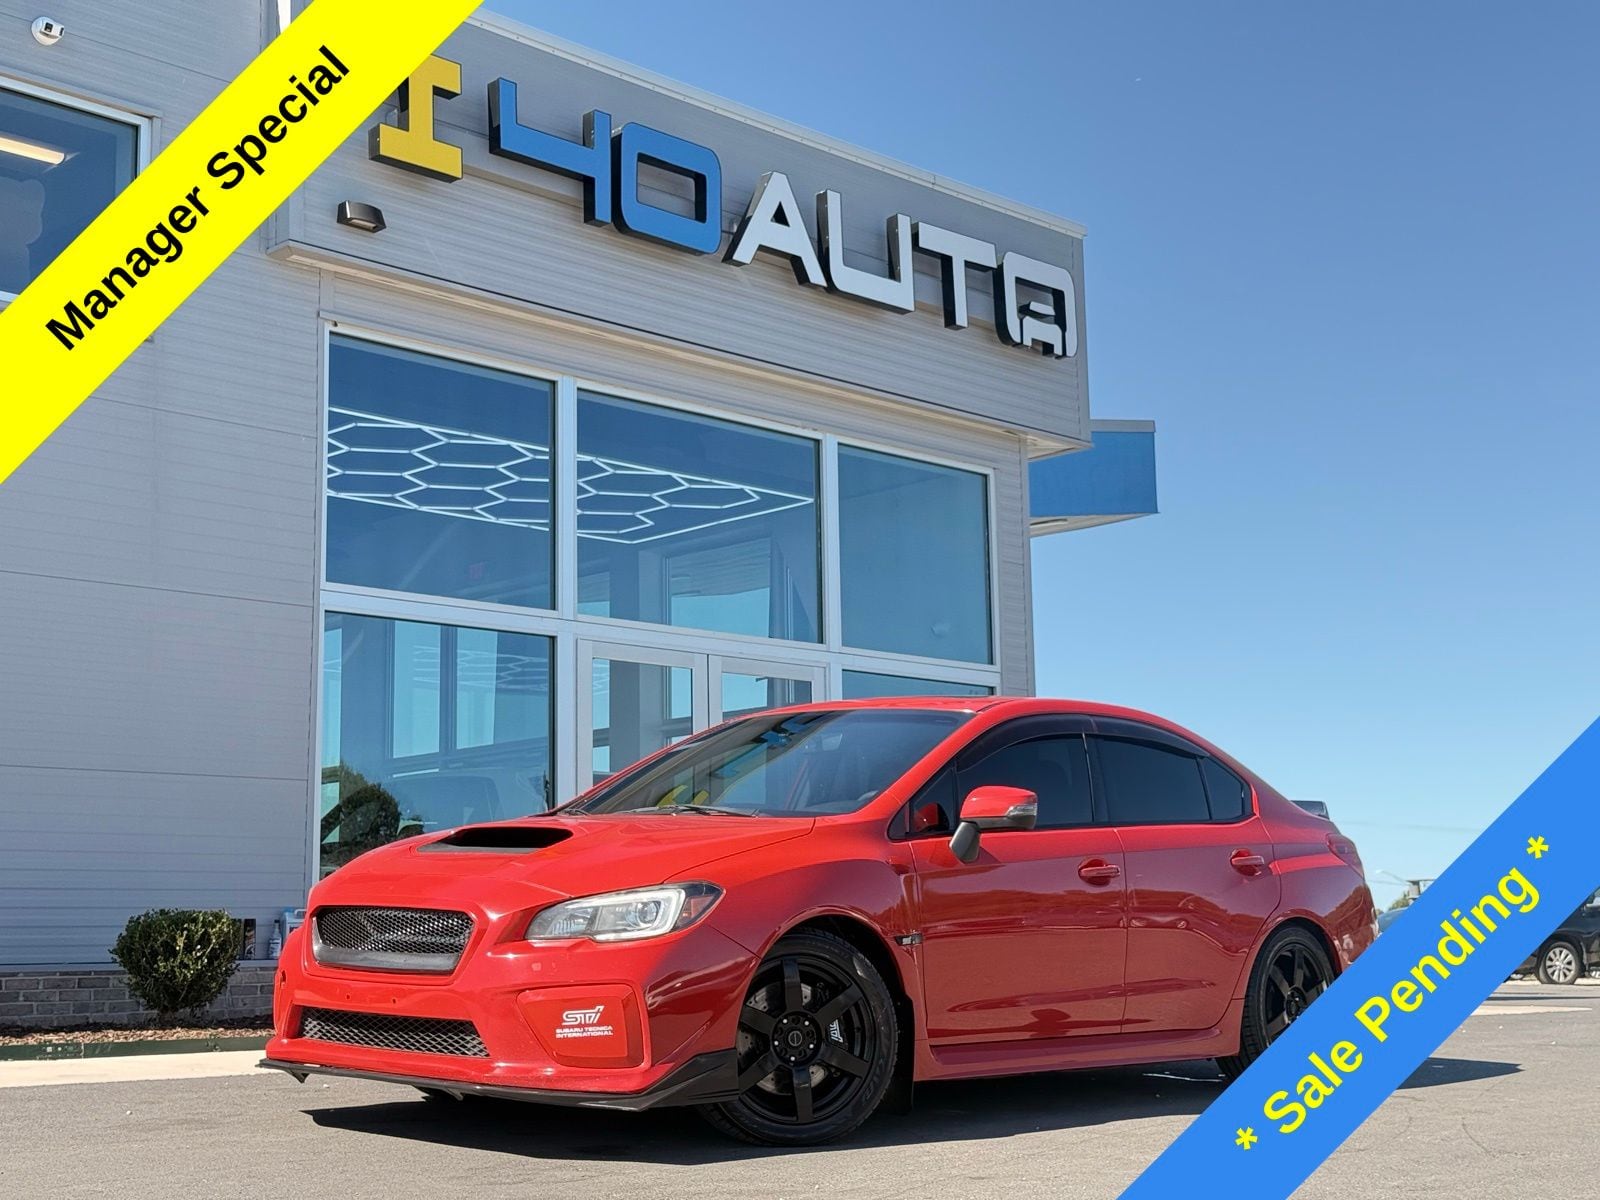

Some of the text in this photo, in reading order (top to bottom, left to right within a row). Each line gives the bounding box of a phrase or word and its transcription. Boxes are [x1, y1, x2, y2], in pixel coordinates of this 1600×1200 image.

[371, 54, 1078, 358] I 40 AUTO
